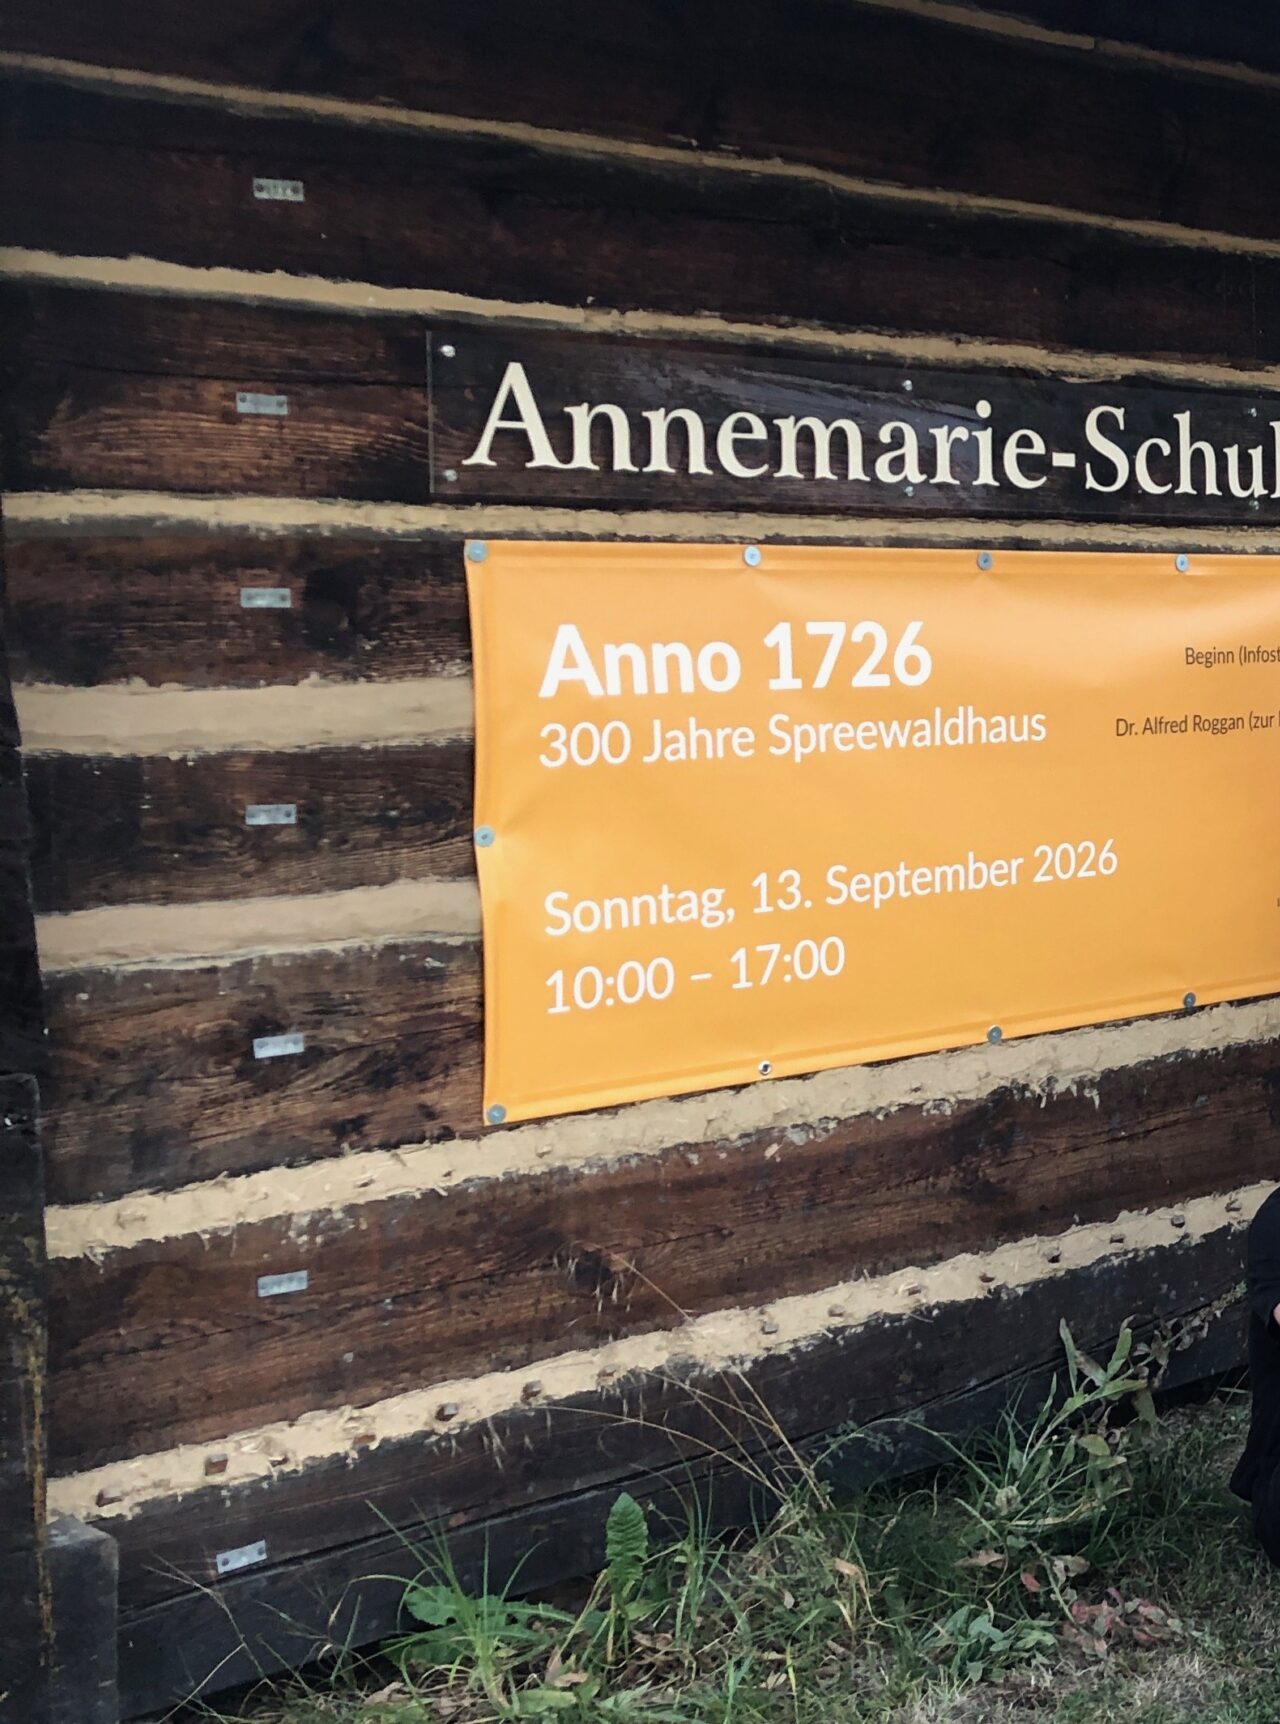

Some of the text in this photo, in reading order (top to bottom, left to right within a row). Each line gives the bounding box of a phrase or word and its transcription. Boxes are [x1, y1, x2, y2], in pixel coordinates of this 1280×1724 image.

[539, 620, 933, 698] Anno 1726
[1185, 646, 1235, 669] Beginn
[539, 705, 1047, 769] 300 Jahre Spreewaldhaus
[1115, 716, 1139, 737] Dr.
[1142, 714, 1189, 736] Alfred
[1193, 714, 1245, 735] Roggan
[1248, 710, 1276, 732] (zur
[543, 838, 1119, 937] Sonntag, 13. September 2026
[544, 956, 676, 1014] 10:00
[729, 935, 847, 989] 17:00
